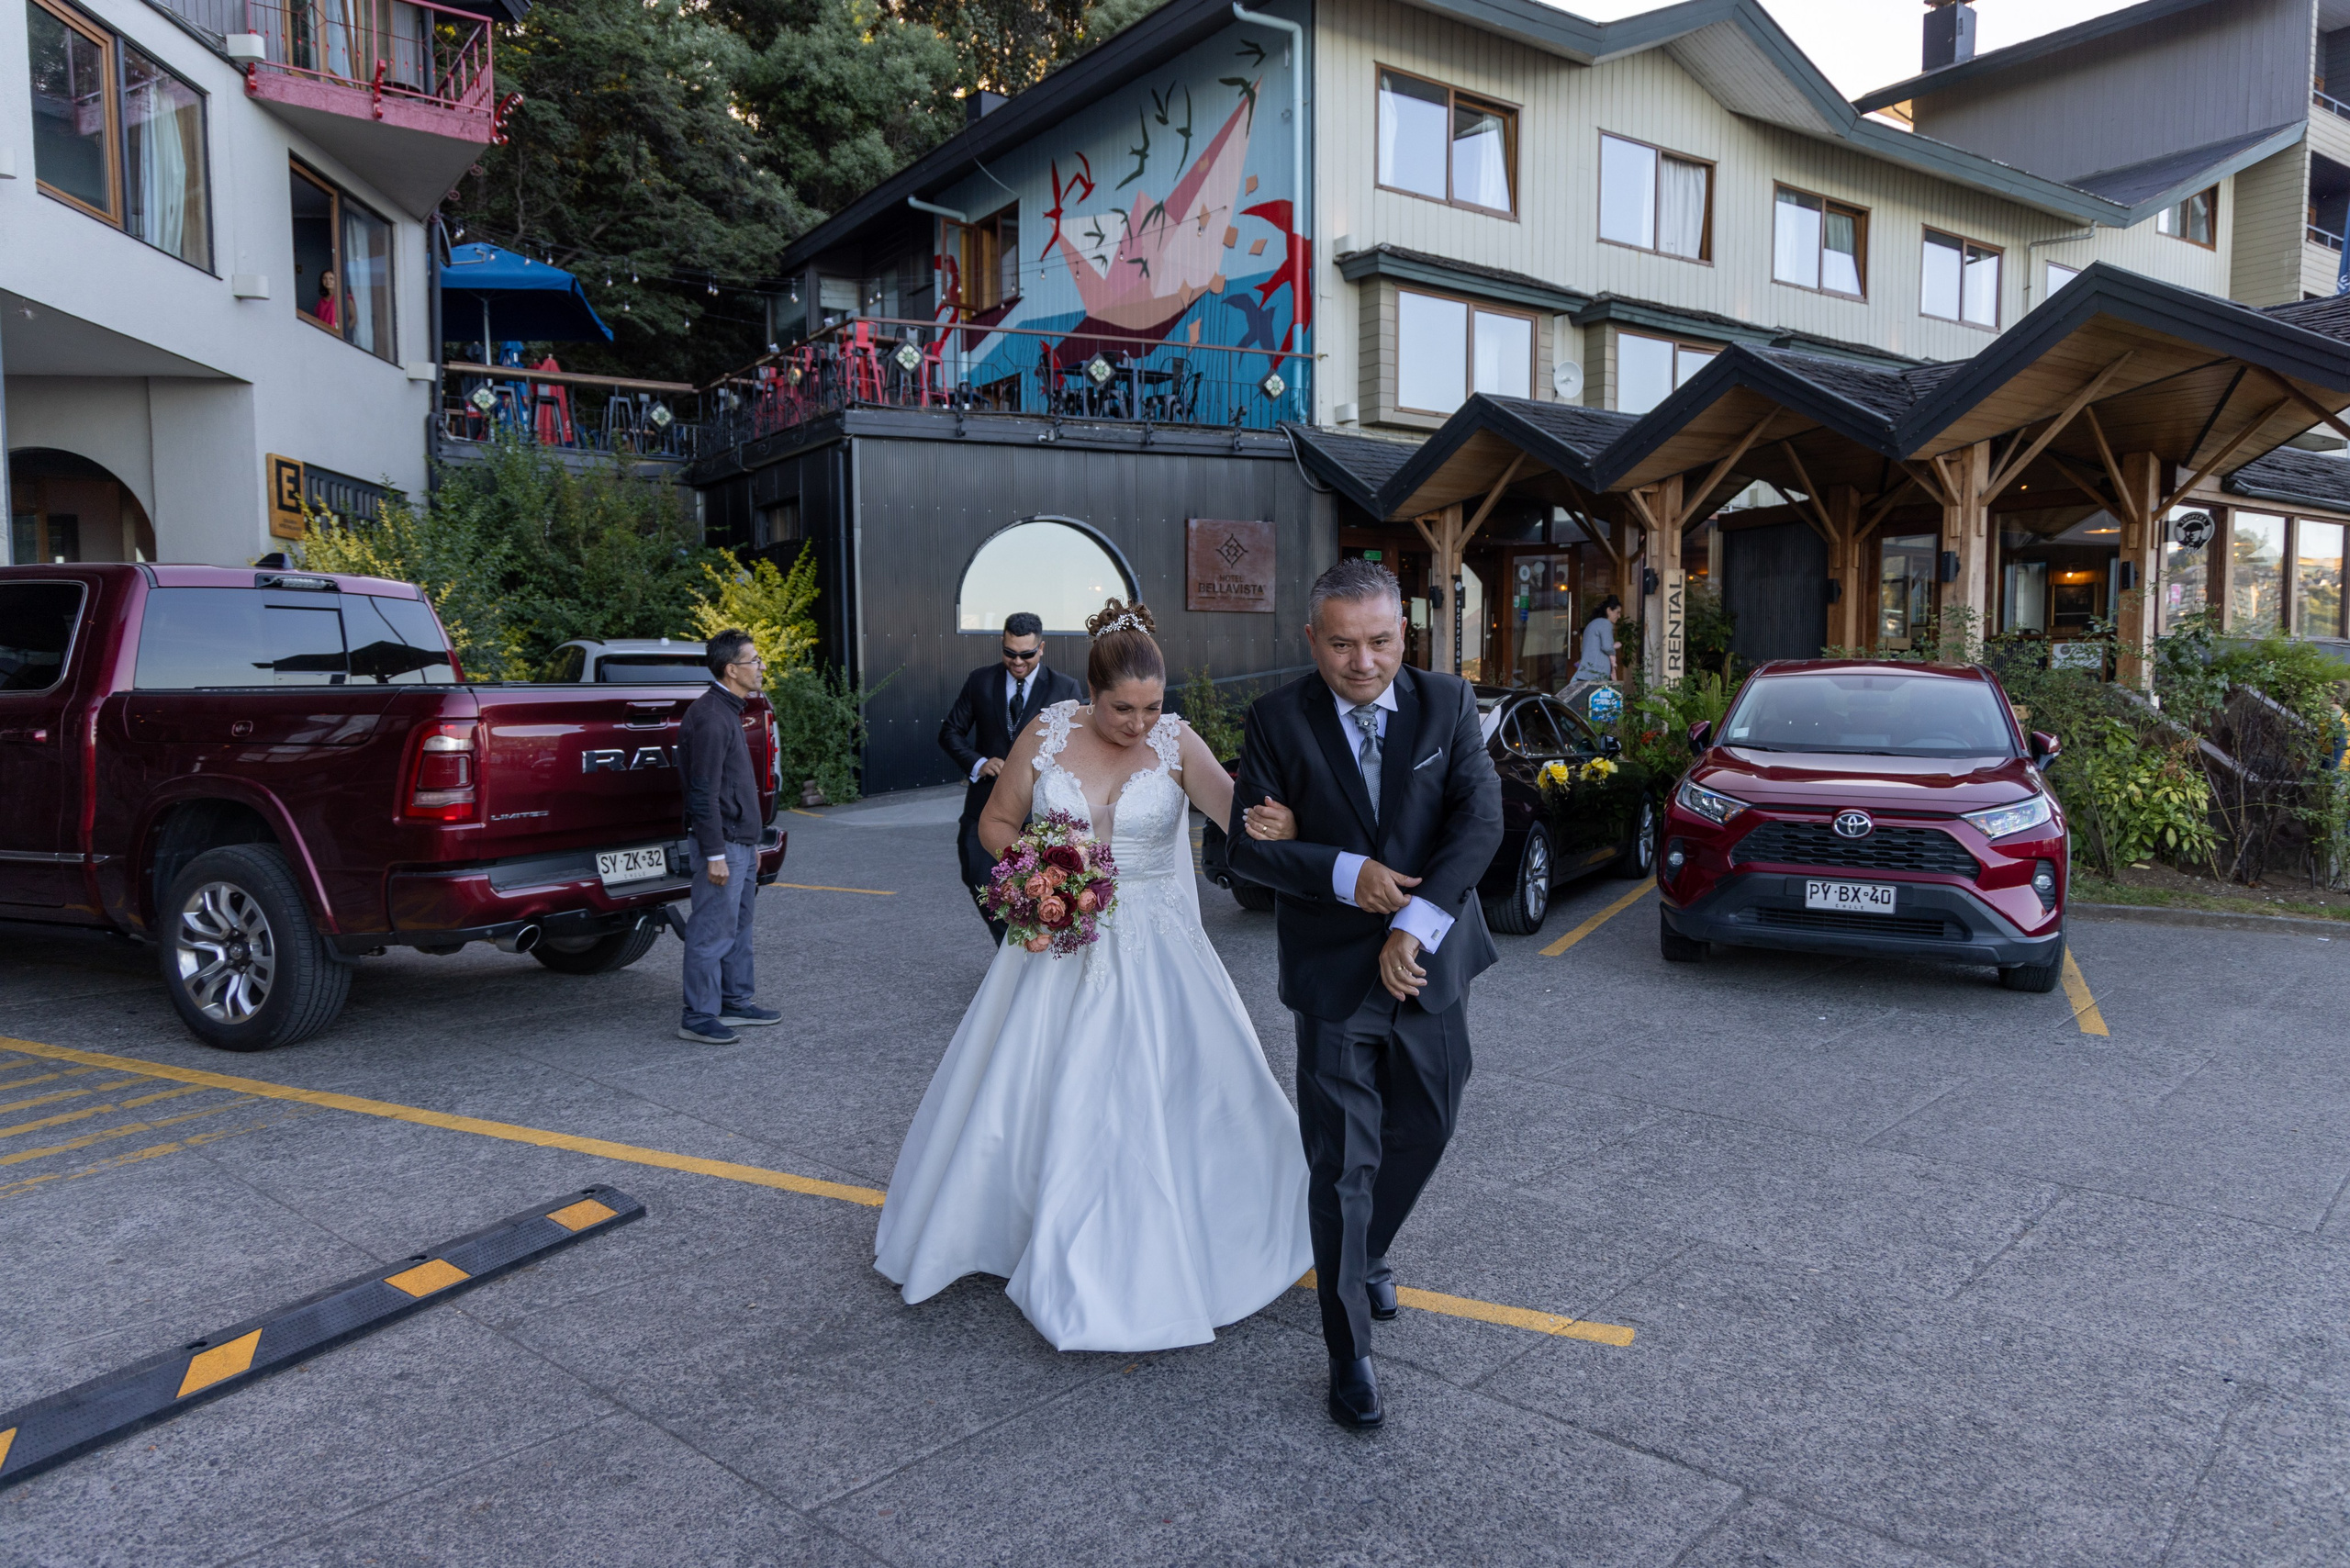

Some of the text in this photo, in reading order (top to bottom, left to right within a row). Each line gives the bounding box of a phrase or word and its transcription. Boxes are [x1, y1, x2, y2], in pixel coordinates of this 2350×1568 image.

[1219, 575, 1244, 583] HOTEL
[1198, 582, 1264, 595] BELLAVISTA
[1668, 574, 1683, 671] RENTAL
[582, 745, 678, 773] RA
[490, 810, 550, 821] LIMITED
